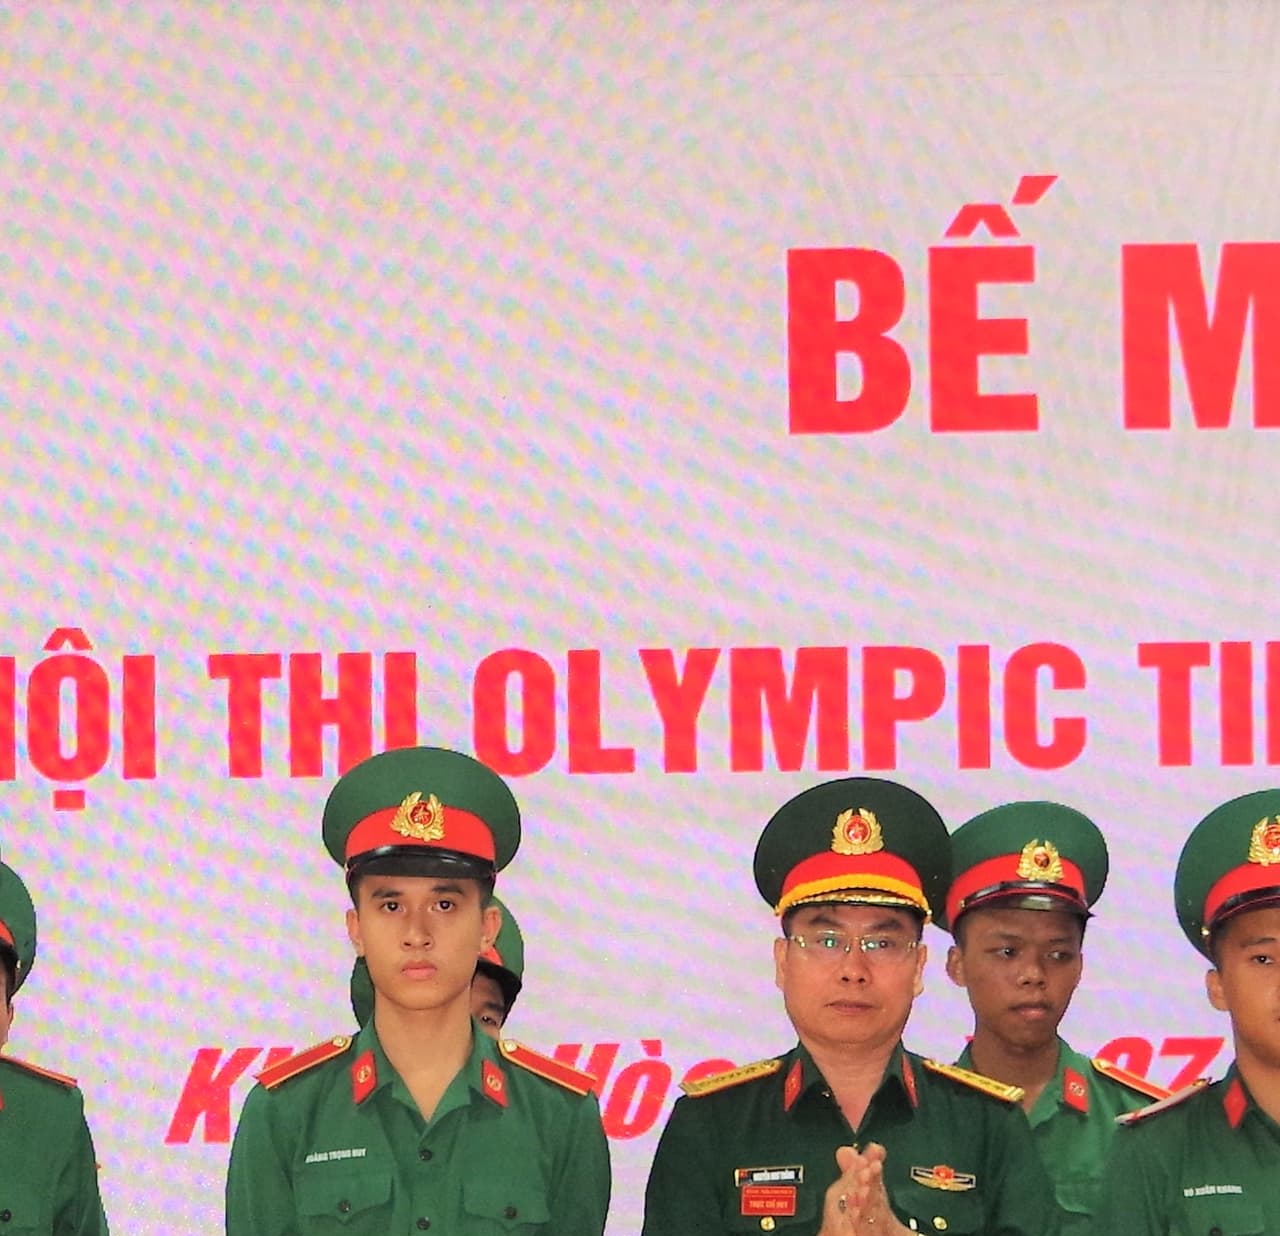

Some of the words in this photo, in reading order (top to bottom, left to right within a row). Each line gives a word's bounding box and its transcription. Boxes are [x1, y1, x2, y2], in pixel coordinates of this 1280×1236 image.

[786, 174, 1059, 435] BẾ
[209, 651, 418, 778] THI
[473, 642, 1087, 778] OLYMPIC
